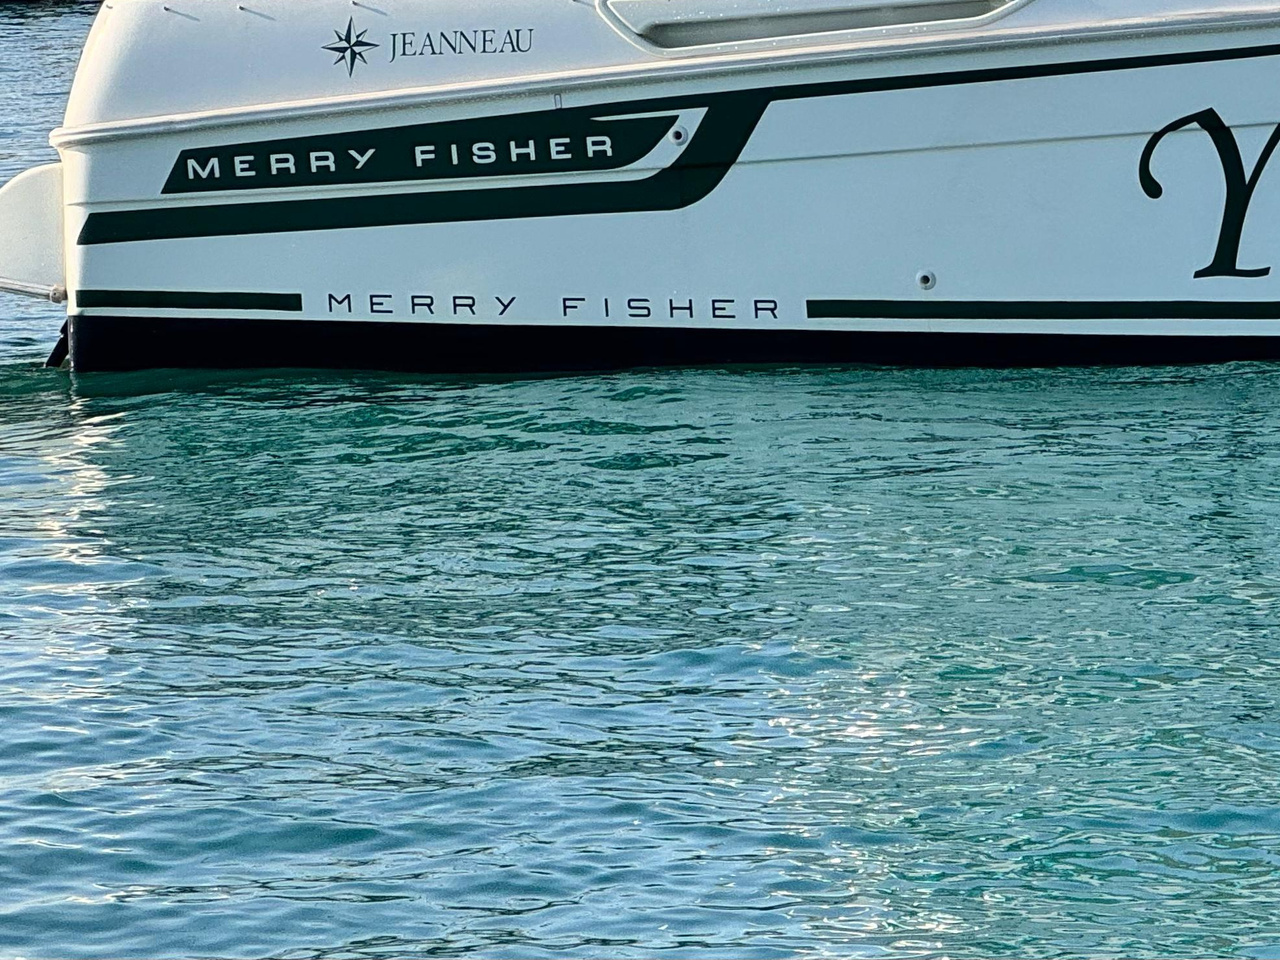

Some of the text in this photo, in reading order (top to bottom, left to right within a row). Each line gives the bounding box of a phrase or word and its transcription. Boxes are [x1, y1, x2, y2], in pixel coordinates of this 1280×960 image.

[389, 28, 534, 64] JEANNEAU
[186, 135, 613, 180] MERRY FISHER
[327, 293, 778, 319] MERRY FISHER
